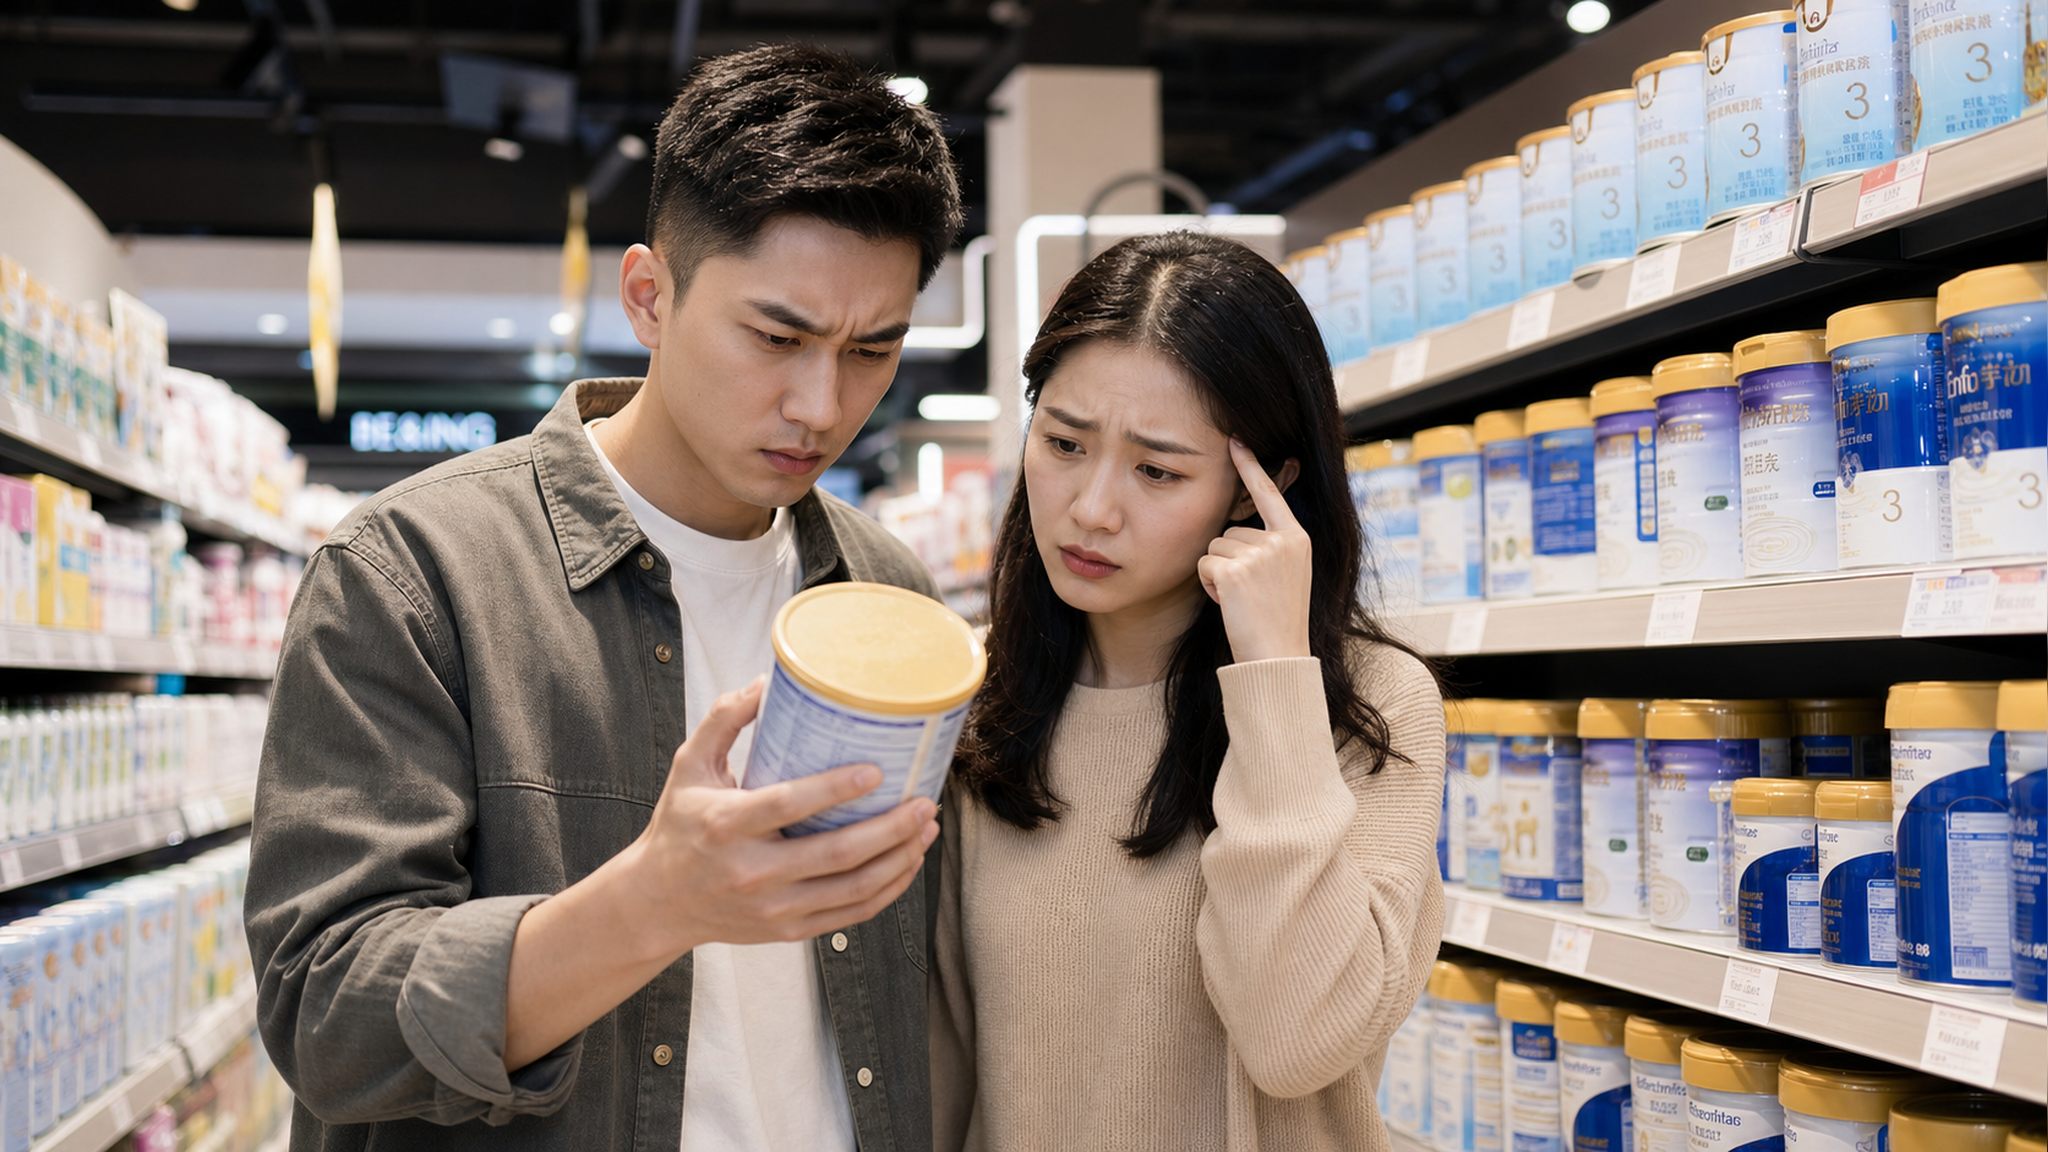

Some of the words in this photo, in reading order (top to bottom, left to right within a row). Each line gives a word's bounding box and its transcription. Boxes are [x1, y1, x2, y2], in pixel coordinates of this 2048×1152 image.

[1965, 42, 1992, 82] 3
[1845, 82, 1870, 120] 3
[1740, 122, 1761, 158] 3
[1667, 156, 1688, 190] 3
[1601, 187, 1621, 220] 3
[1547, 219, 1567, 249] 3
[1882, 489, 1903, 522] 3
[2018, 472, 2043, 510] 3
